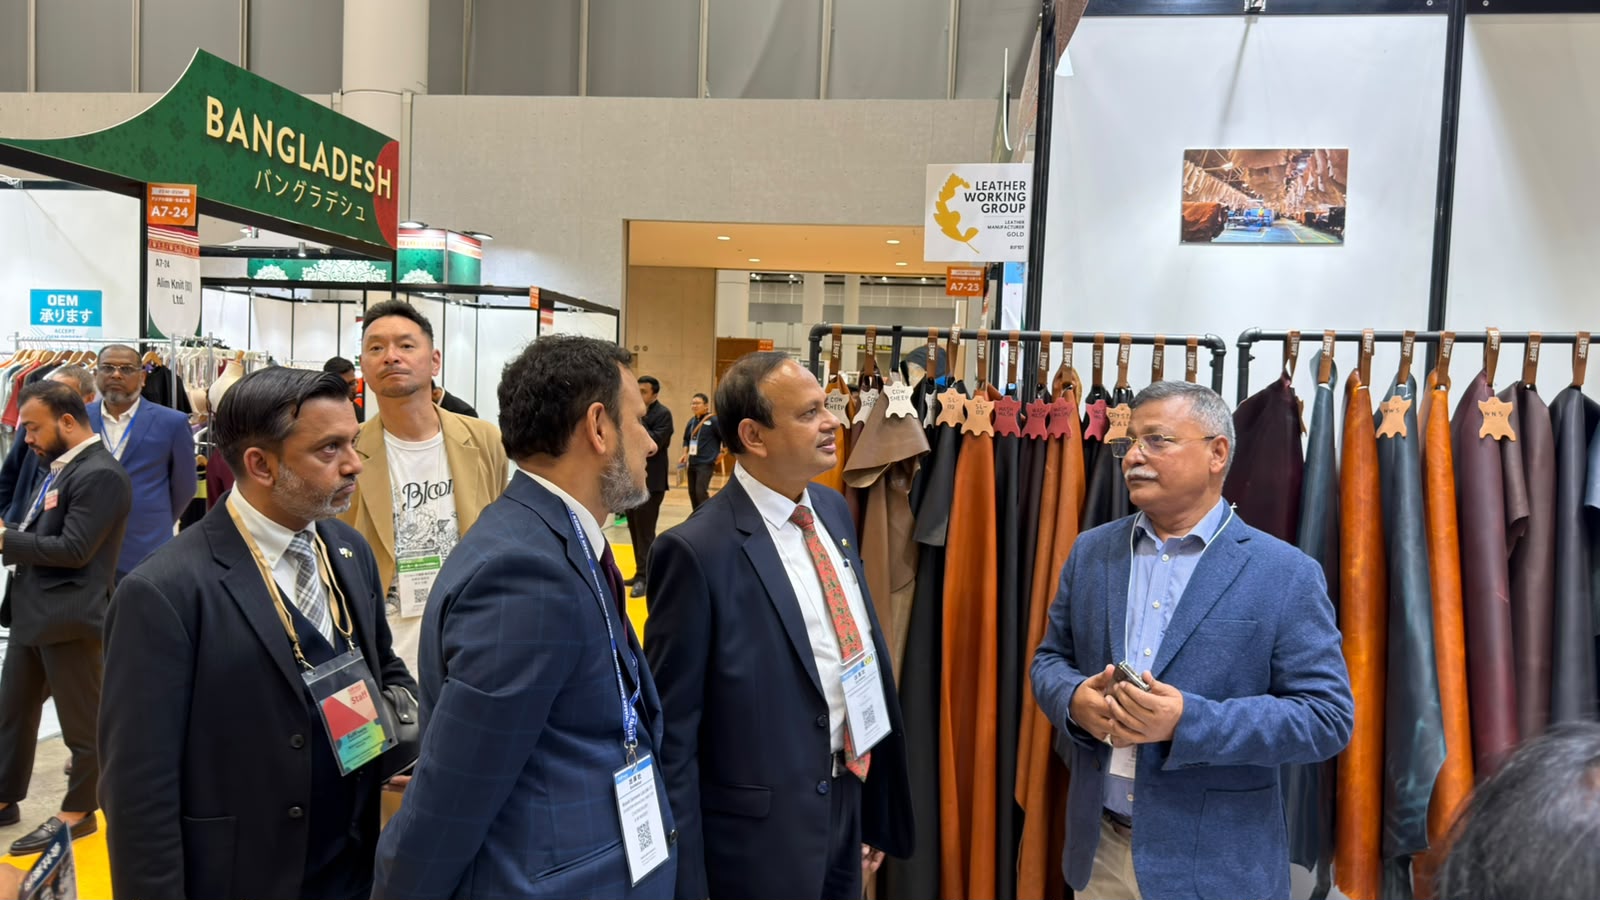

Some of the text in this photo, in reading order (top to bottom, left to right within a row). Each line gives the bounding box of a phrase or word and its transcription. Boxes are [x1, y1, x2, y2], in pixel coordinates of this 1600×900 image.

[206, 95, 391, 200] BANGLADESH
[975, 180, 1026, 191] LEATHER
[254, 168, 366, 222] バングラデシュ
[964, 192, 1026, 202] WORKING
[151, 206, 188, 218] A7-24
[981, 203, 1026, 214] GROUP
[156, 258, 170, 268] A7-24
[156, 277, 170, 288] Alim
[171, 278, 184, 290] Knit
[950, 282, 980, 292] A7-23
[47, 294, 78, 306] OEM
[172, 294, 185, 304] Ltd.
[40, 308, 93, 324] 承ります
[351, 690, 368, 704] Staff
